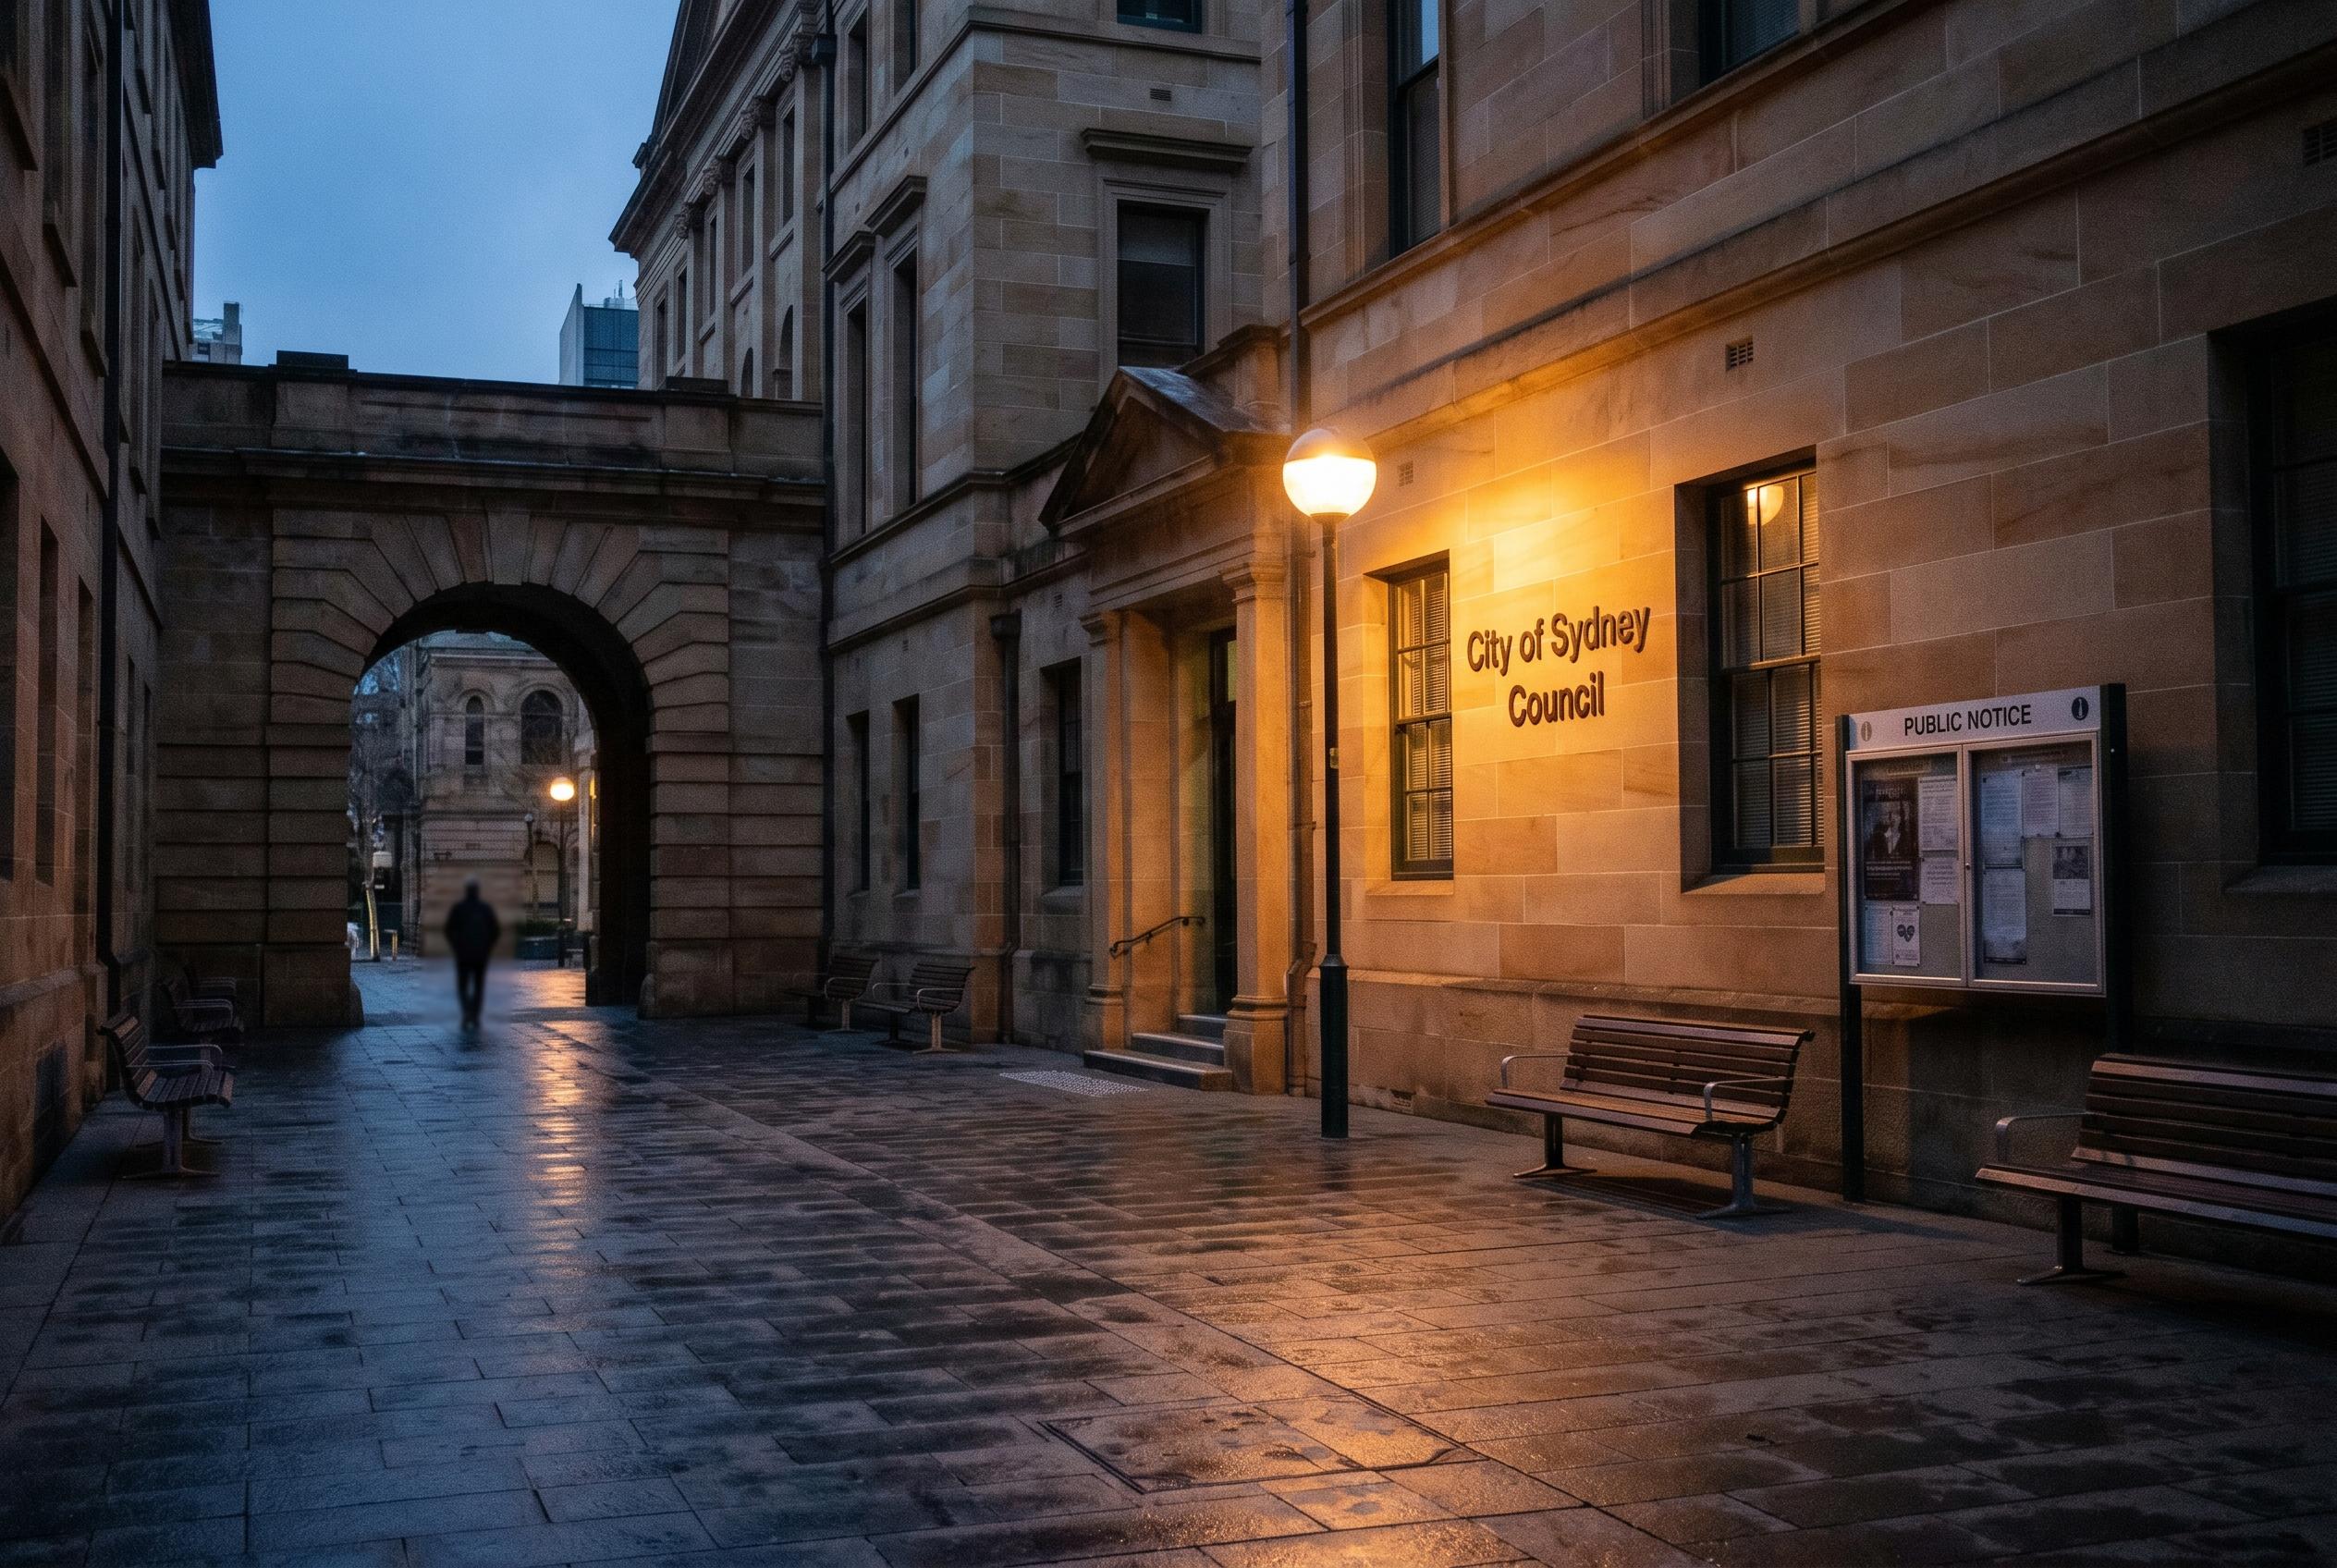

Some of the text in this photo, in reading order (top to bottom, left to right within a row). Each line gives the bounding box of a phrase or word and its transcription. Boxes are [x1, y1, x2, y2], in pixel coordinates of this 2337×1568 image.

[1467, 606, 1651, 677] City of Sydney
[1509, 670, 1605, 728] Council
[1904, 704, 2032, 736] PUBLIC NOTICE
